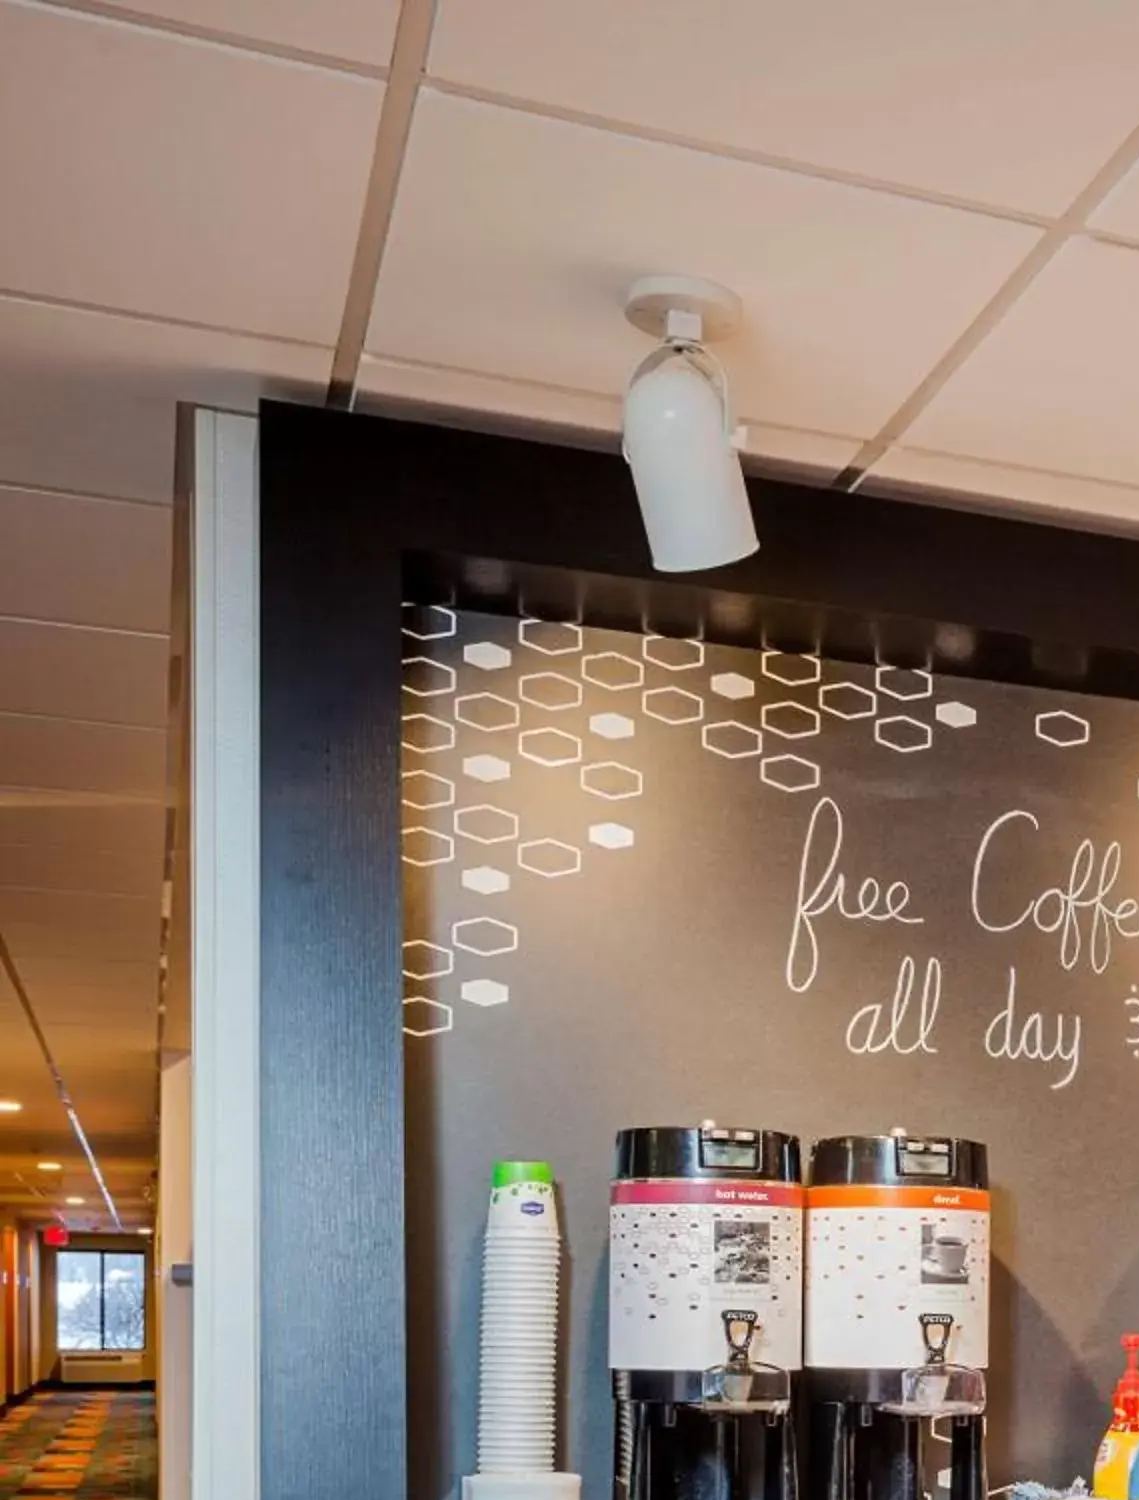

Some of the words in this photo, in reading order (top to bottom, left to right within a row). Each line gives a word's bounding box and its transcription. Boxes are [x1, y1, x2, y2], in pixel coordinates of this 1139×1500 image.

[787, 797, 924, 992] free
[845, 956, 939, 1054] all
[984, 967, 1082, 1089] day
